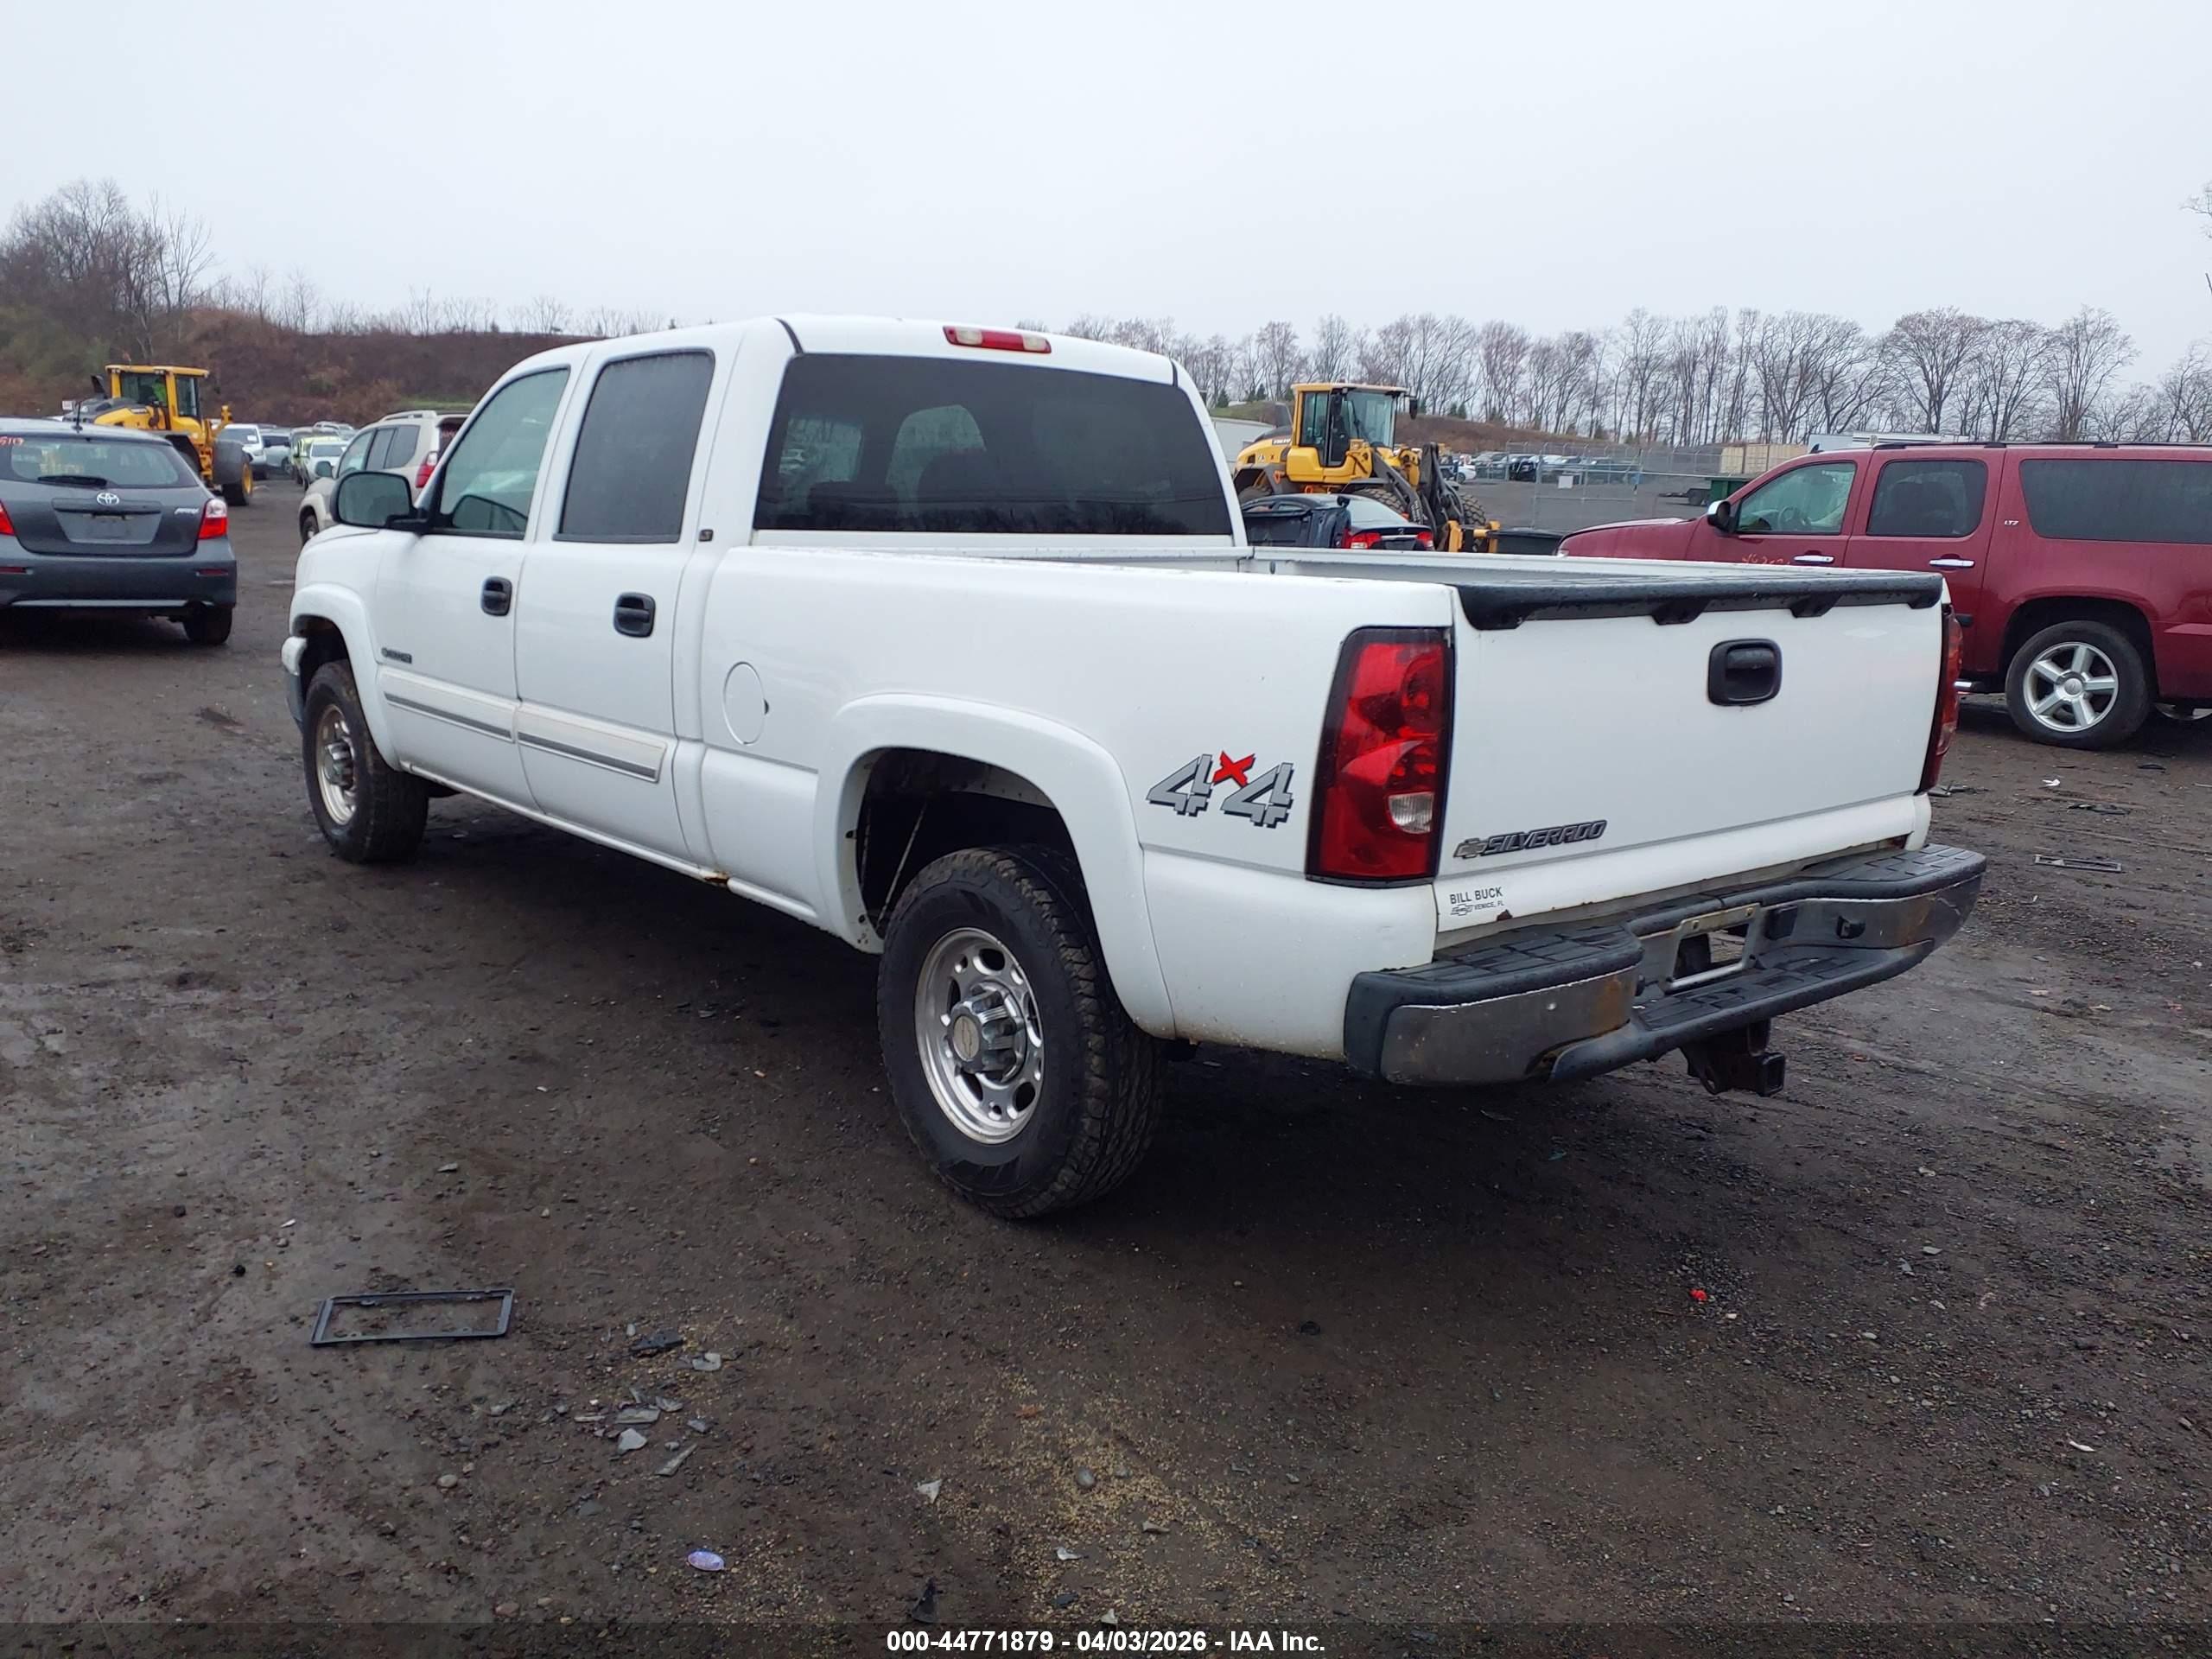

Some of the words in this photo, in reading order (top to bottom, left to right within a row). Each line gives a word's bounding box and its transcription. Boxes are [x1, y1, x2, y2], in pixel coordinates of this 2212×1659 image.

[1482, 820, 1607, 855] SILVERADO
[1449, 891, 1472, 905] BILL
[1474, 886, 1503, 900] BUCK
